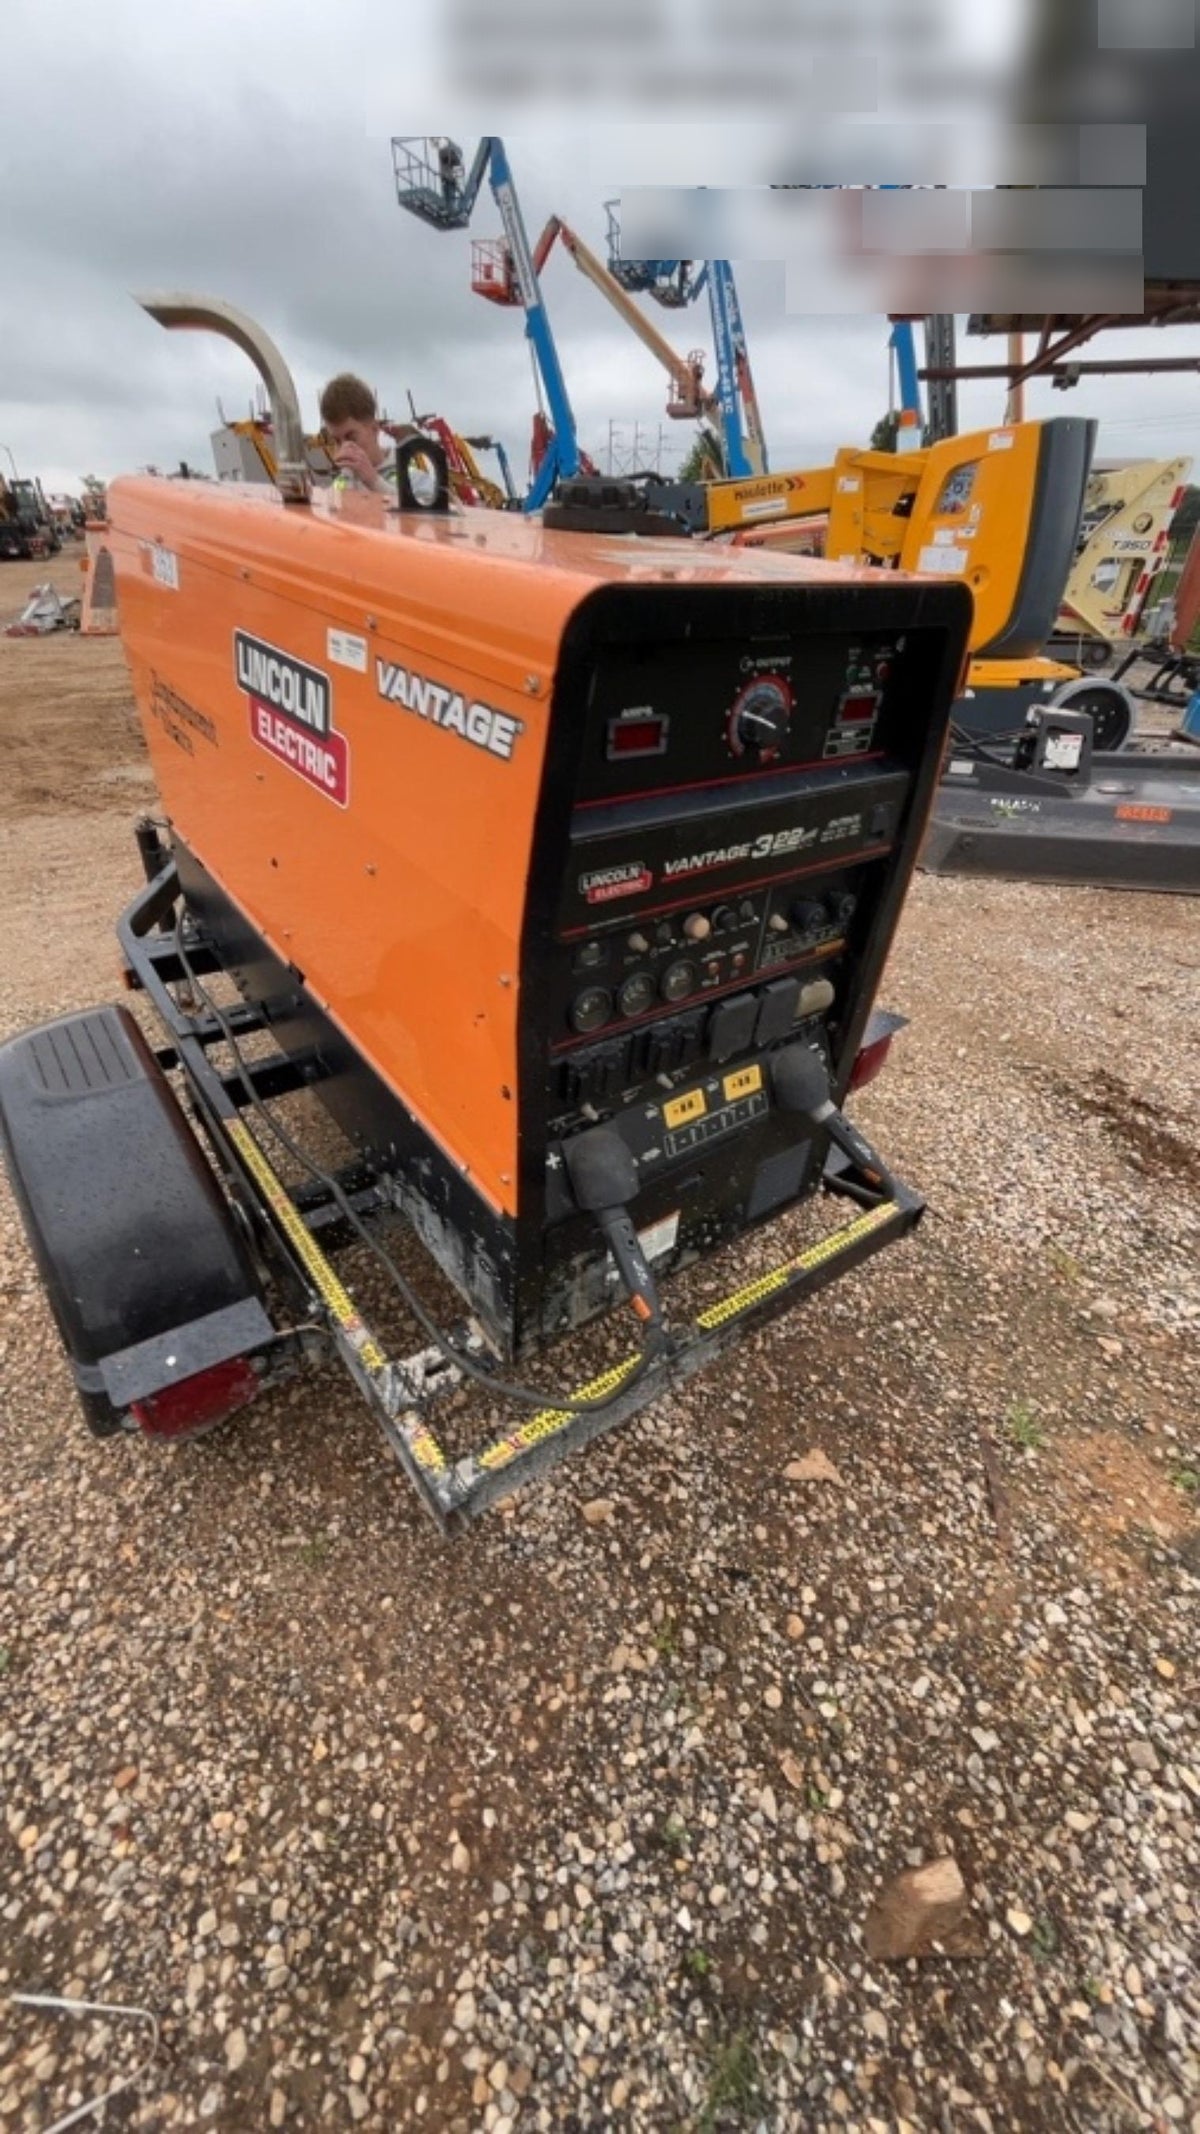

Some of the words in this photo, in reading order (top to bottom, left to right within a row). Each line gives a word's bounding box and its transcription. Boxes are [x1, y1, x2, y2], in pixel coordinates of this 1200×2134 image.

[755, 656, 793, 668] OUTPUT
[237, 639, 327, 733] LINCOLN
[375, 660, 520, 758] VANTAGE
[621, 707, 653, 718] AMPS
[256, 708, 338, 790] ELECTRIC
[663, 842, 752, 875] VANTAGE
[583, 865, 642, 890] LINCOLN
[595, 877, 645, 898] ELECTRIC
